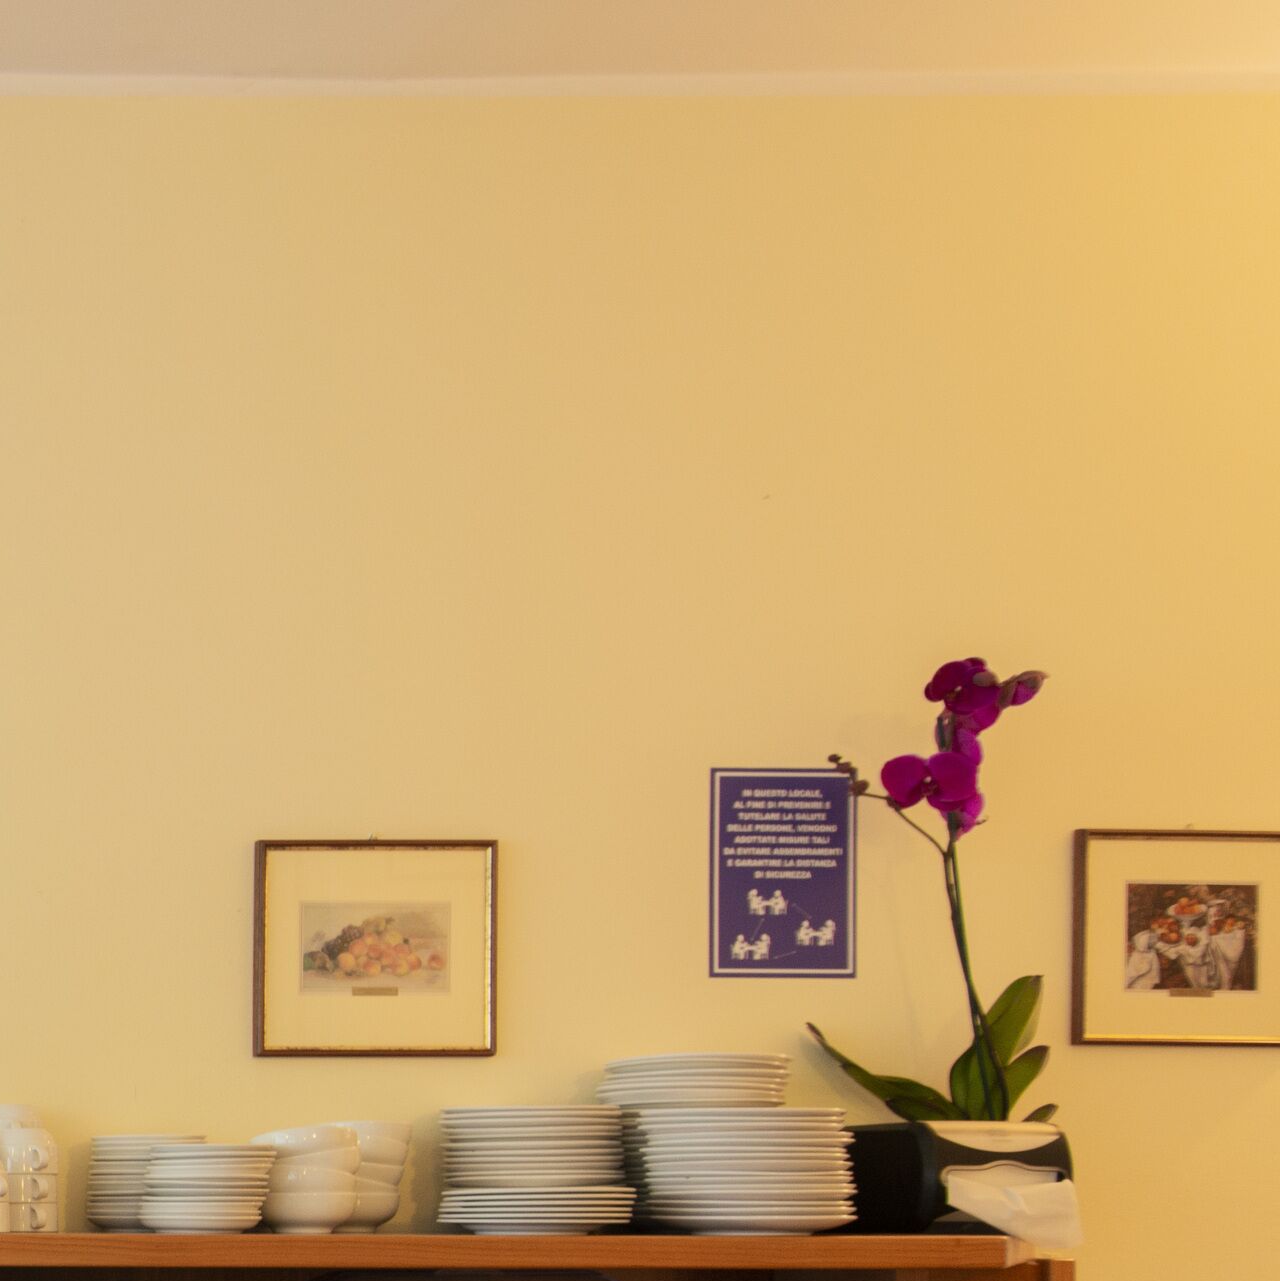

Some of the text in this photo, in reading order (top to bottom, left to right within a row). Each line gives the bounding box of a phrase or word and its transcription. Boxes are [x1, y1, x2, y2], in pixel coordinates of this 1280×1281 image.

[753, 789, 787, 797] QUESTO
[746, 801, 766, 809] FINE
[778, 801, 822, 809] PREVENIRE
[738, 812, 780, 820] TUTELARE
[795, 812, 827, 820] SALUTE
[727, 824, 753, 832] DELLE
[736, 847, 771, 855] EVITARE
[734, 859, 781, 867] GARANTIRE
[796, 859, 837, 867] DISTANZA
[765, 870, 812, 879] SICUREZZA
